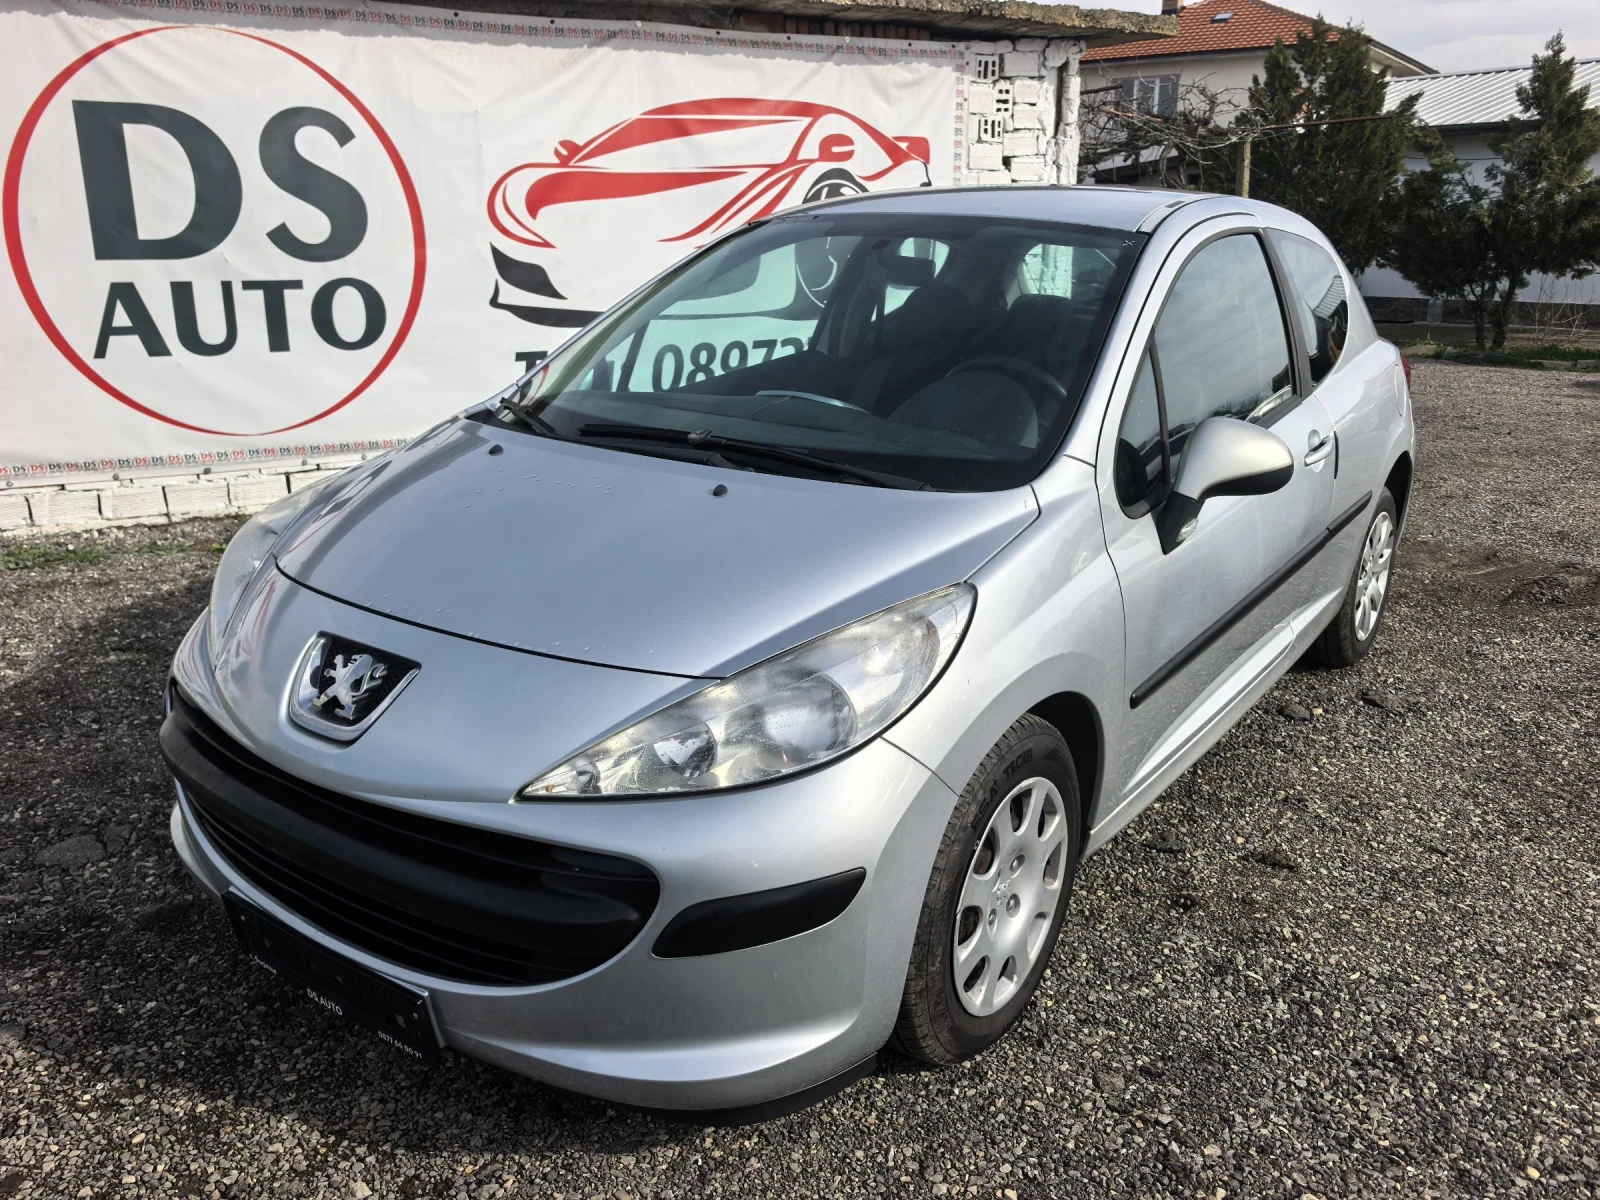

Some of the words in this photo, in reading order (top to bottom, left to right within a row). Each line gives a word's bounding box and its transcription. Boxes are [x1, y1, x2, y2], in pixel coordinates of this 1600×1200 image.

[72, 99, 368, 263] DS
[93, 277, 387, 359] AUTO
[306, 987, 319, 1002] DS
[320, 996, 343, 1016] AUTO
